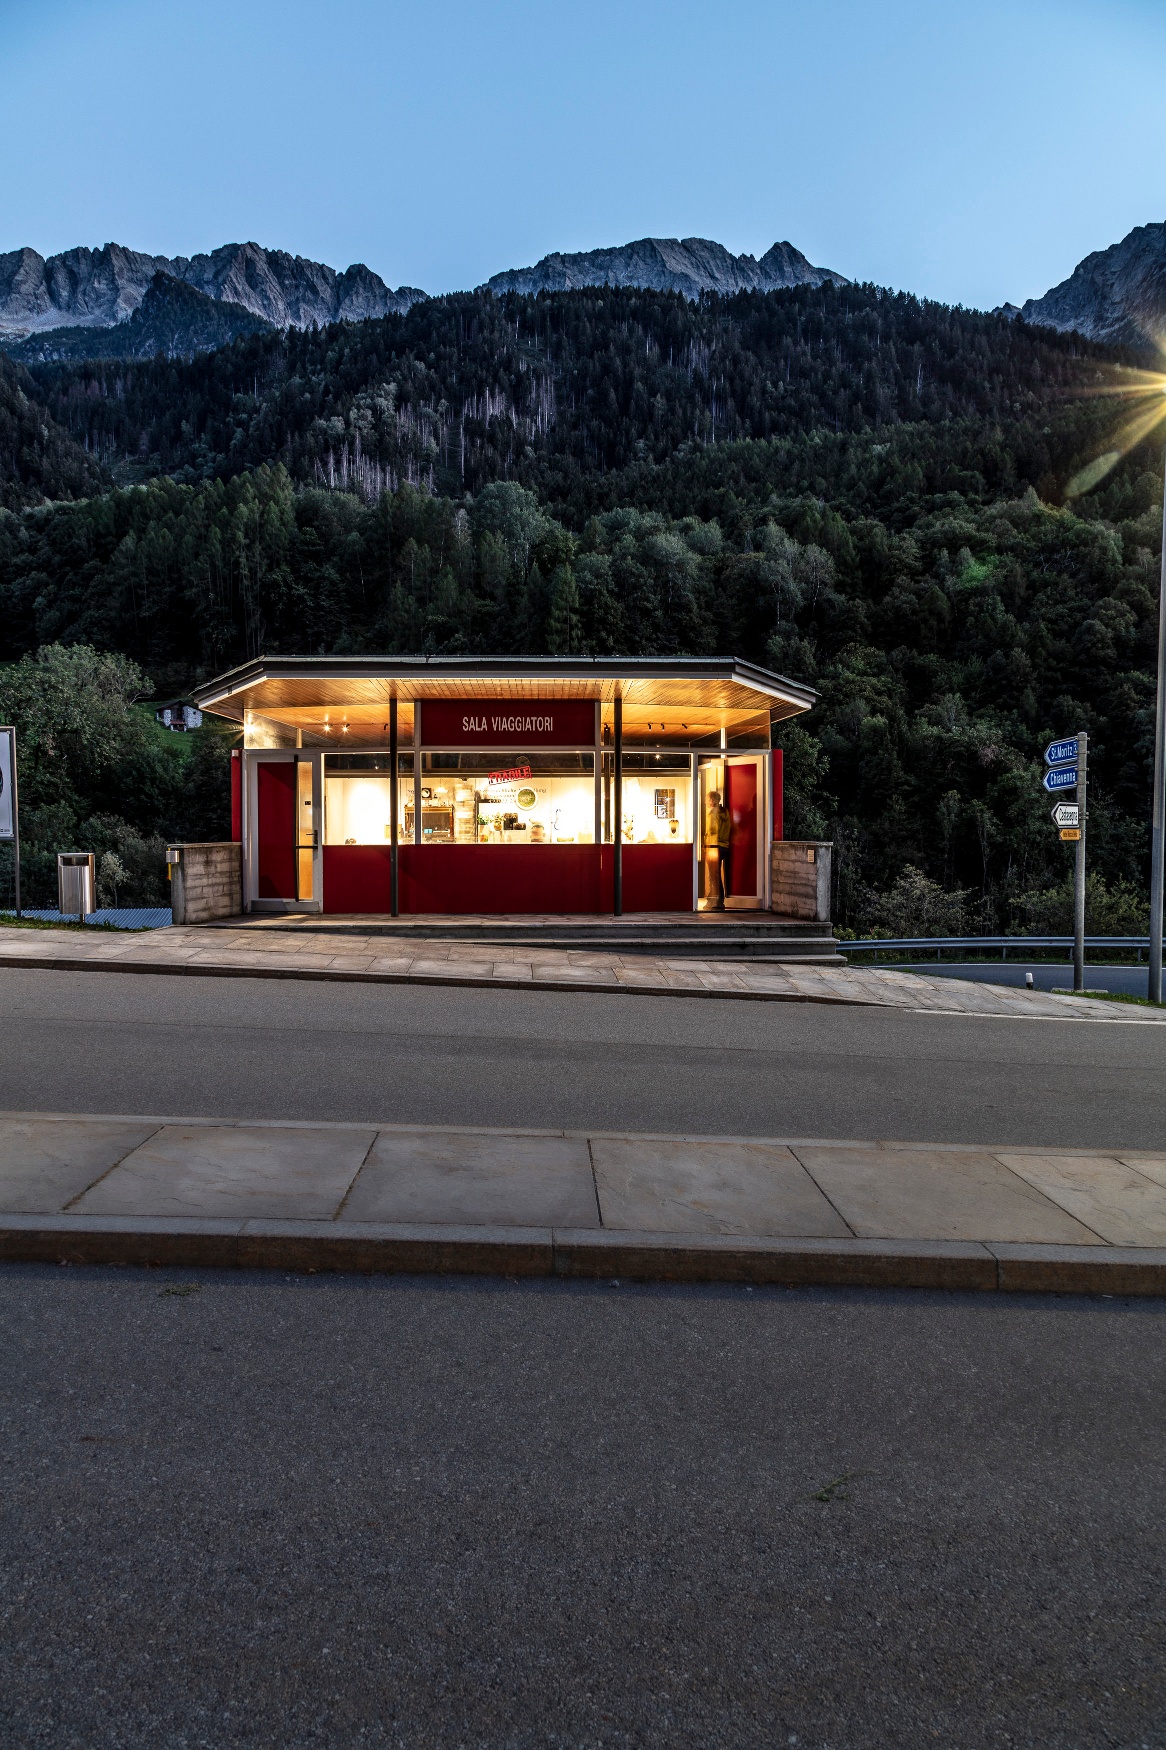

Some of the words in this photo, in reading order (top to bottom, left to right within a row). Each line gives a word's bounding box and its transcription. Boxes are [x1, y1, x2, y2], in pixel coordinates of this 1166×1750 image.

[462, 716, 488, 731] SALA
[491, 716, 553, 731] VIAGGIATORI
[1050, 772, 1076, 786] Chiavenna
